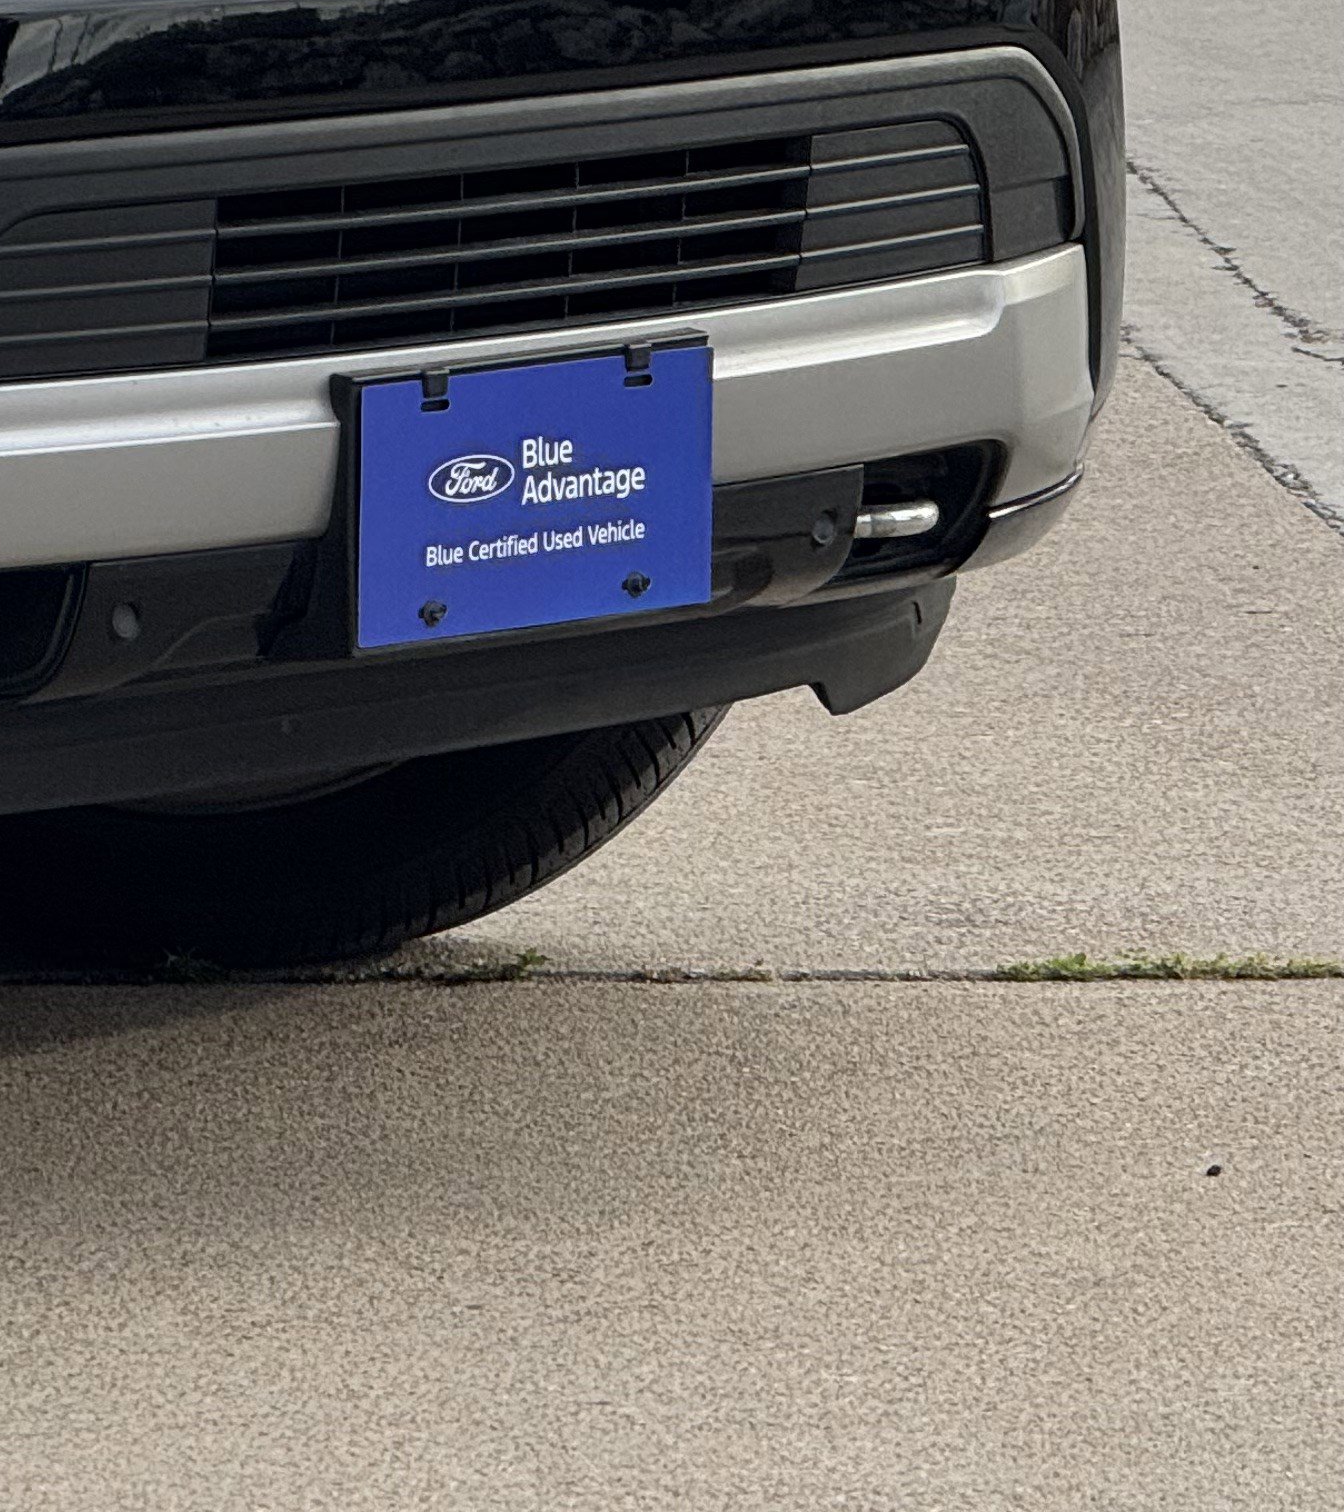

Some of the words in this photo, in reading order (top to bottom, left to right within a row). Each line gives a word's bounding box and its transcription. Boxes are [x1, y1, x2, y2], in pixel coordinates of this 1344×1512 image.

[522, 436, 573, 469] Blue
[445, 462, 499, 496] Ford
[521, 464, 645, 506] Advantage
[426, 543, 463, 567] Blue
[468, 534, 538, 562] Certified
[543, 526, 583, 552] Used
[588, 519, 645, 546] Vehicle
